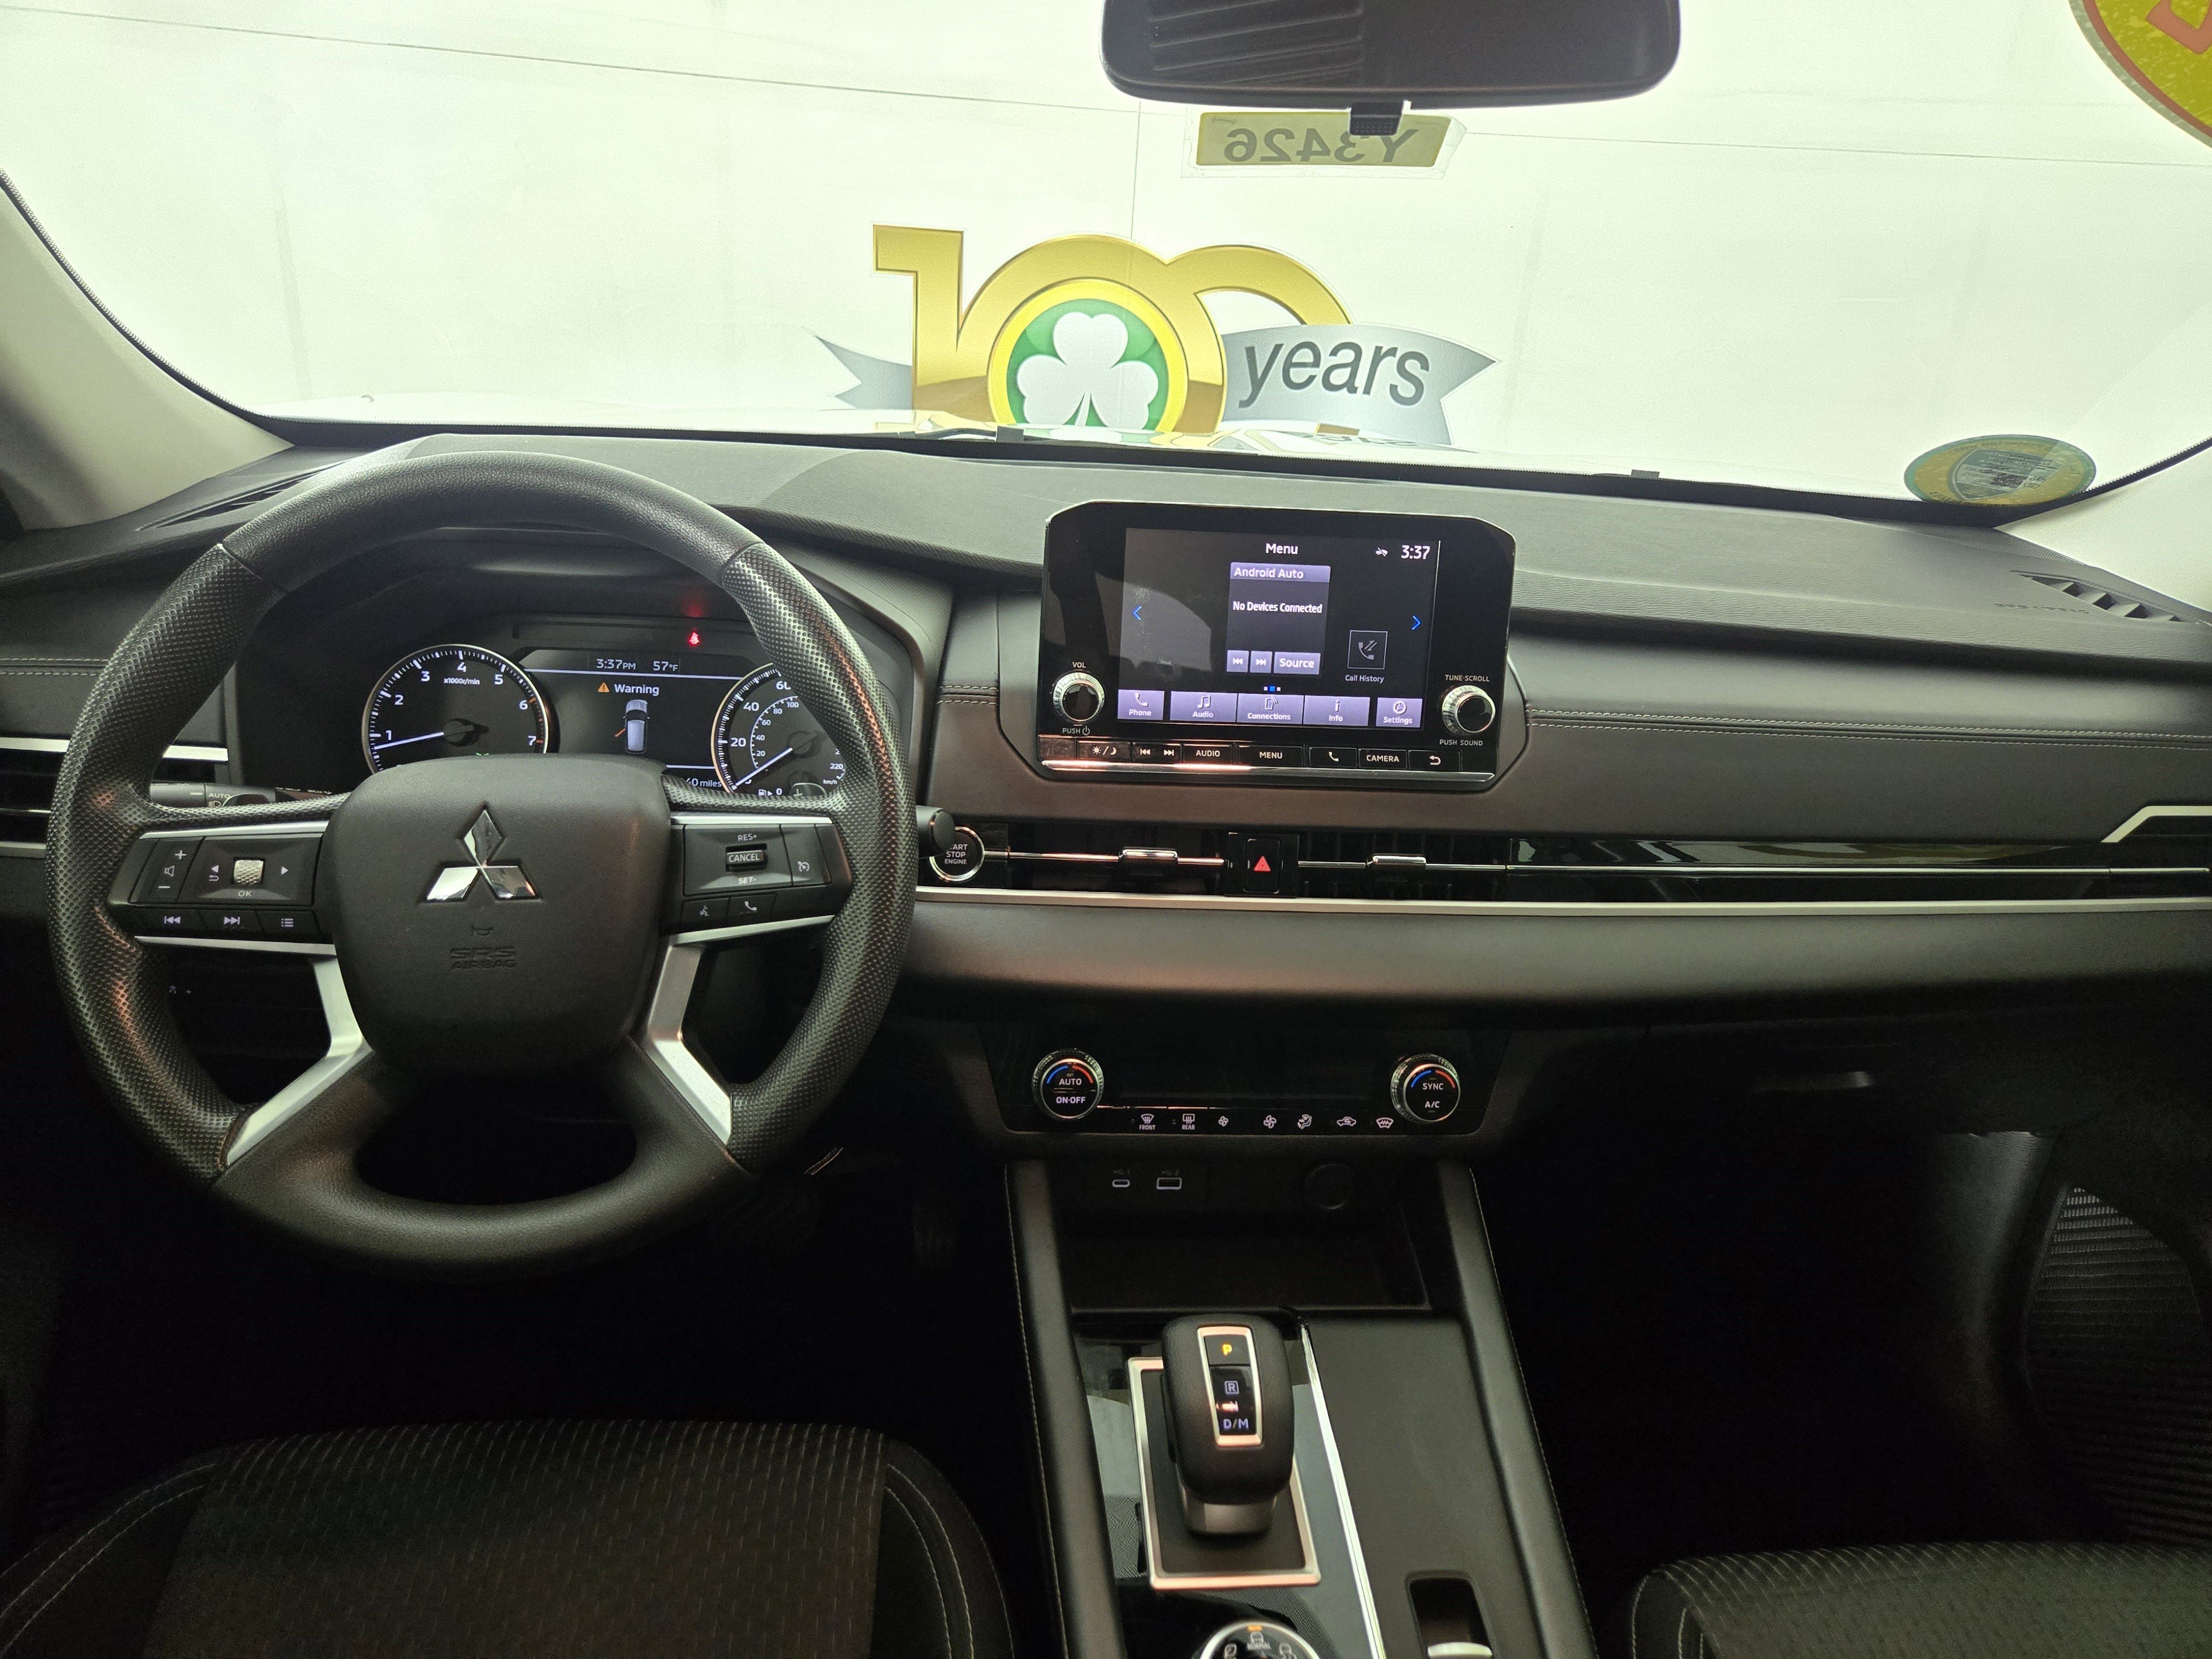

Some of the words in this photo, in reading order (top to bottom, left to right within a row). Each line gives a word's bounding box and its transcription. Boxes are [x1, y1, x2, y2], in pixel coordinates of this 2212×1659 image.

[1239, 340, 1431, 409] years
[1265, 542, 1299, 555] Menu
[1400, 544, 1431, 560] 3:37
[1233, 566, 1277, 579] Android
[1277, 567, 1305, 580] Auto
[1232, 600, 1245, 611] No
[1243, 601, 1279, 612] Devices
[1279, 602, 1323, 614] Connected
[456, 661, 467, 673] 4
[596, 658, 637, 670] 3:37PM
[652, 660, 679, 672] 57°F
[1071, 661, 1087, 670] VOL
[1279, 657, 1316, 669] Source
[420, 670, 431, 682] 3
[443, 677, 481, 686] x1000r/min
[494, 673, 504, 686] 5
[1344, 674, 1359, 682] Call
[1358, 674, 1385, 685] History
[613, 683, 660, 697] Warning
[394, 693, 404, 706] 2
[518, 699, 529, 711] 6
[742, 701, 760, 712] 40
[1128, 708, 1152, 717] Phone
[1192, 709, 1214, 719] Audio
[1246, 712, 1292, 721] Connections
[1328, 714, 1344, 722] Info
[1383, 716, 1413, 726] Settings
[385, 729, 393, 741] 1
[1061, 727, 1082, 736] PUSH
[527, 734, 537, 747] 7
[730, 737, 747, 748] 20
[755, 749, 766, 758] 20
[1195, 749, 1221, 758] AUDIO
[1259, 751, 1284, 760] MENU
[1365, 754, 1400, 763] CAMERA
[699, 779, 723, 788] miles
[737, 833, 758, 842] RES+
[950, 843, 969, 851] ART
[727, 852, 761, 864] CANCEL
[945, 849, 967, 858] STOP
[237, 889, 253, 898] OK
[1058, 1077, 1083, 1086] AUTO
[1422, 1082, 1444, 1091] SYNC
[1424, 1100, 1441, 1109] A/C
[1221, 1343, 1233, 1357] P
[1227, 1382, 1237, 1393] R
[1223, 1417, 1250, 1430] D/M
[1246, 1641, 1271, 1651] NORMAL
